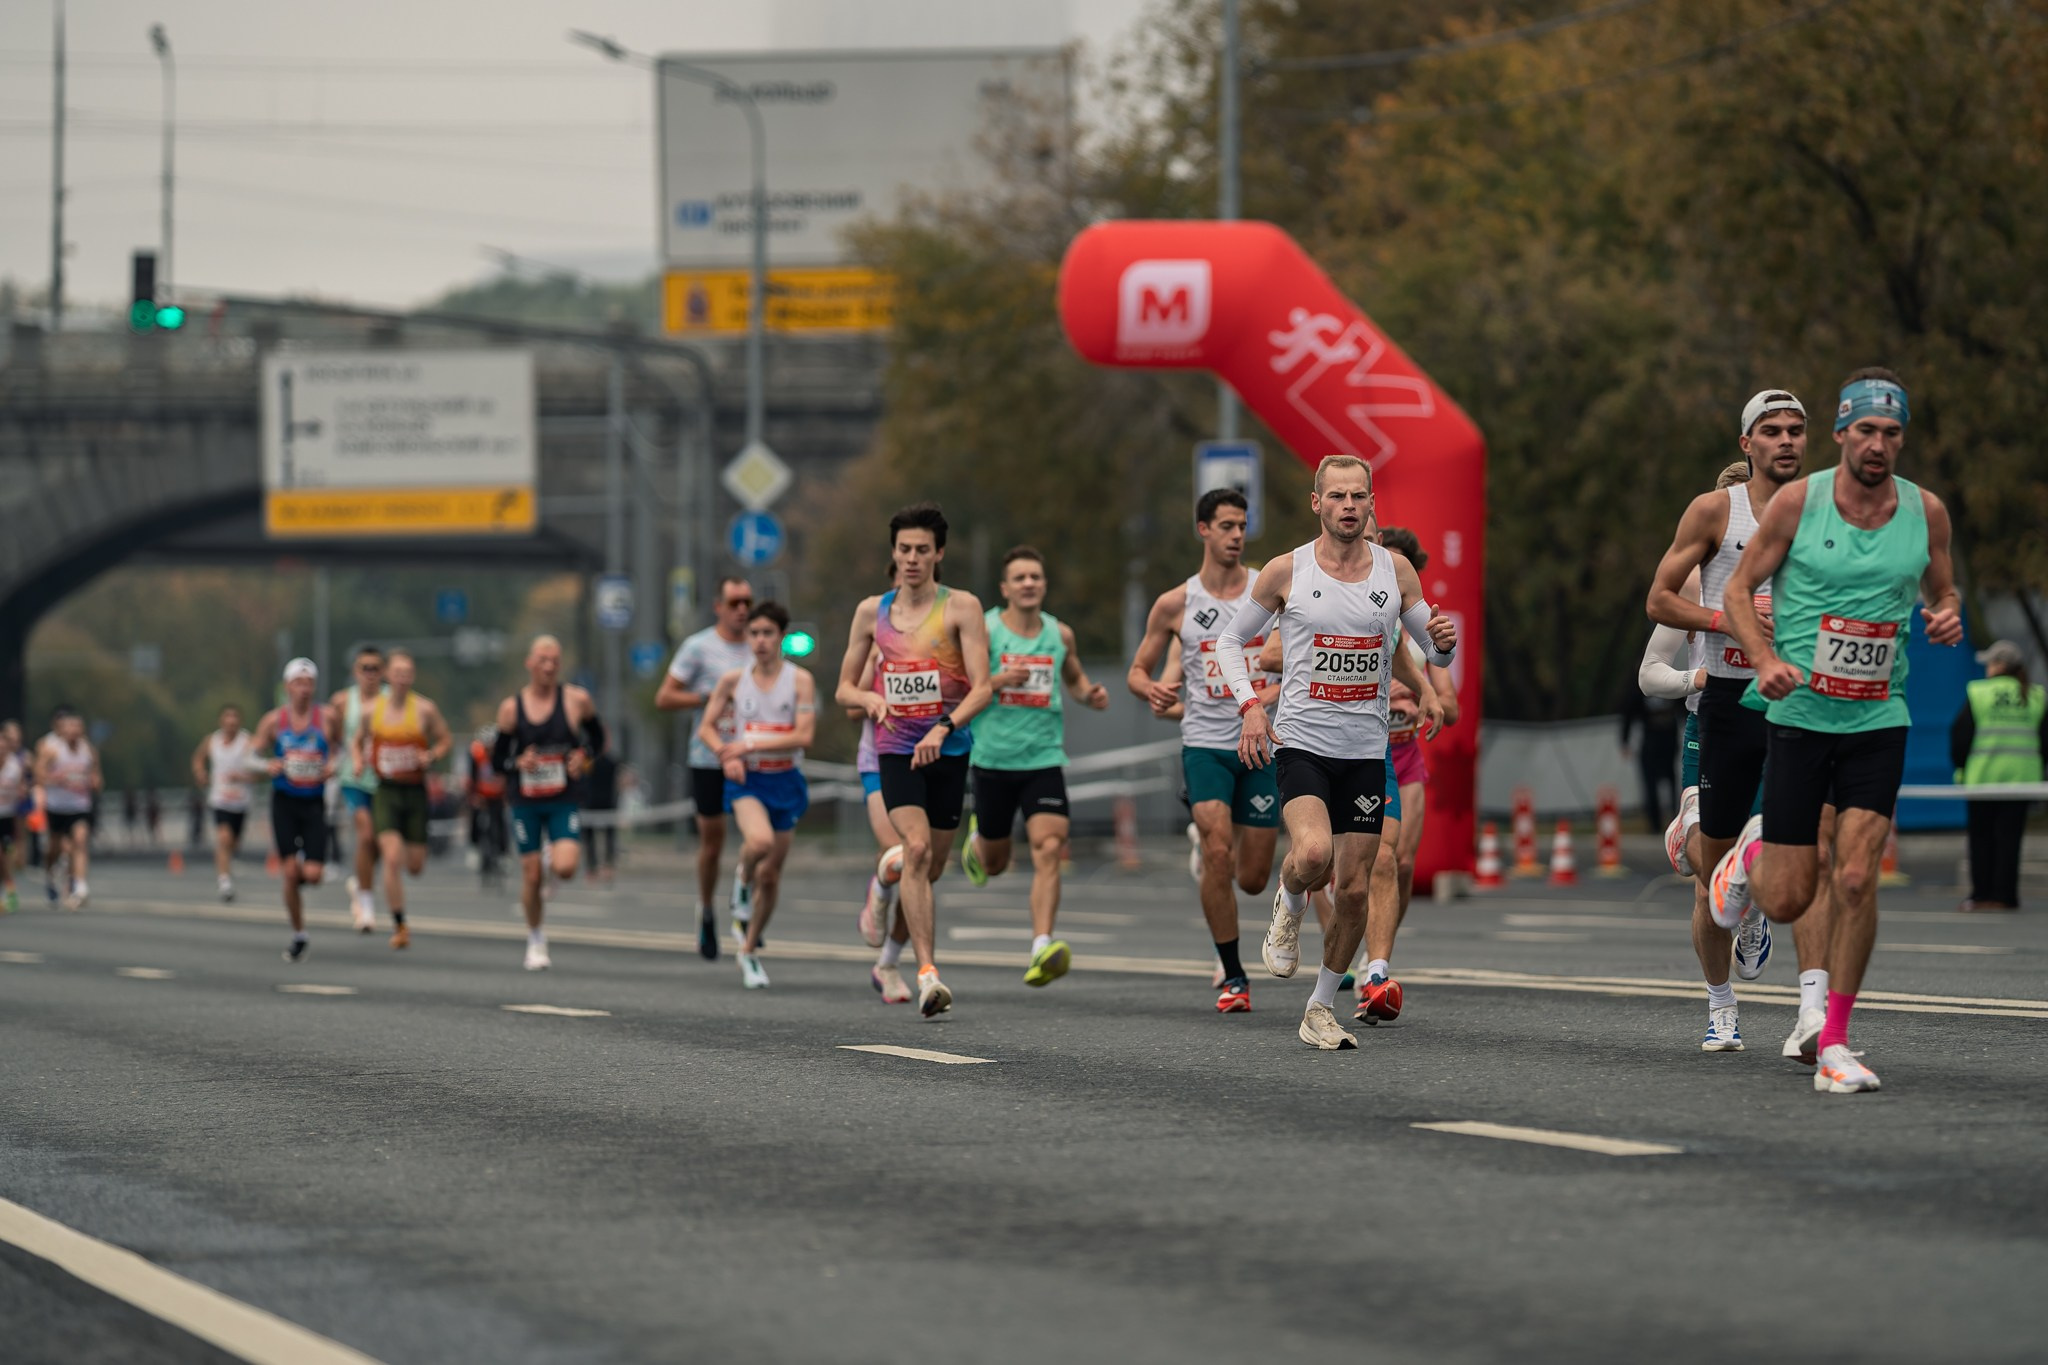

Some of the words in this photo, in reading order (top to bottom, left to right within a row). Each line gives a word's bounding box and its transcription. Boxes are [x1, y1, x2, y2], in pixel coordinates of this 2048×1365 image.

[1315, 651, 1379, 673] 20558
[1828, 637, 1888, 667] 7330
[887, 675, 937, 695] 12684
[1327, 674, 1367, 682] СТАНИСЛАВ
